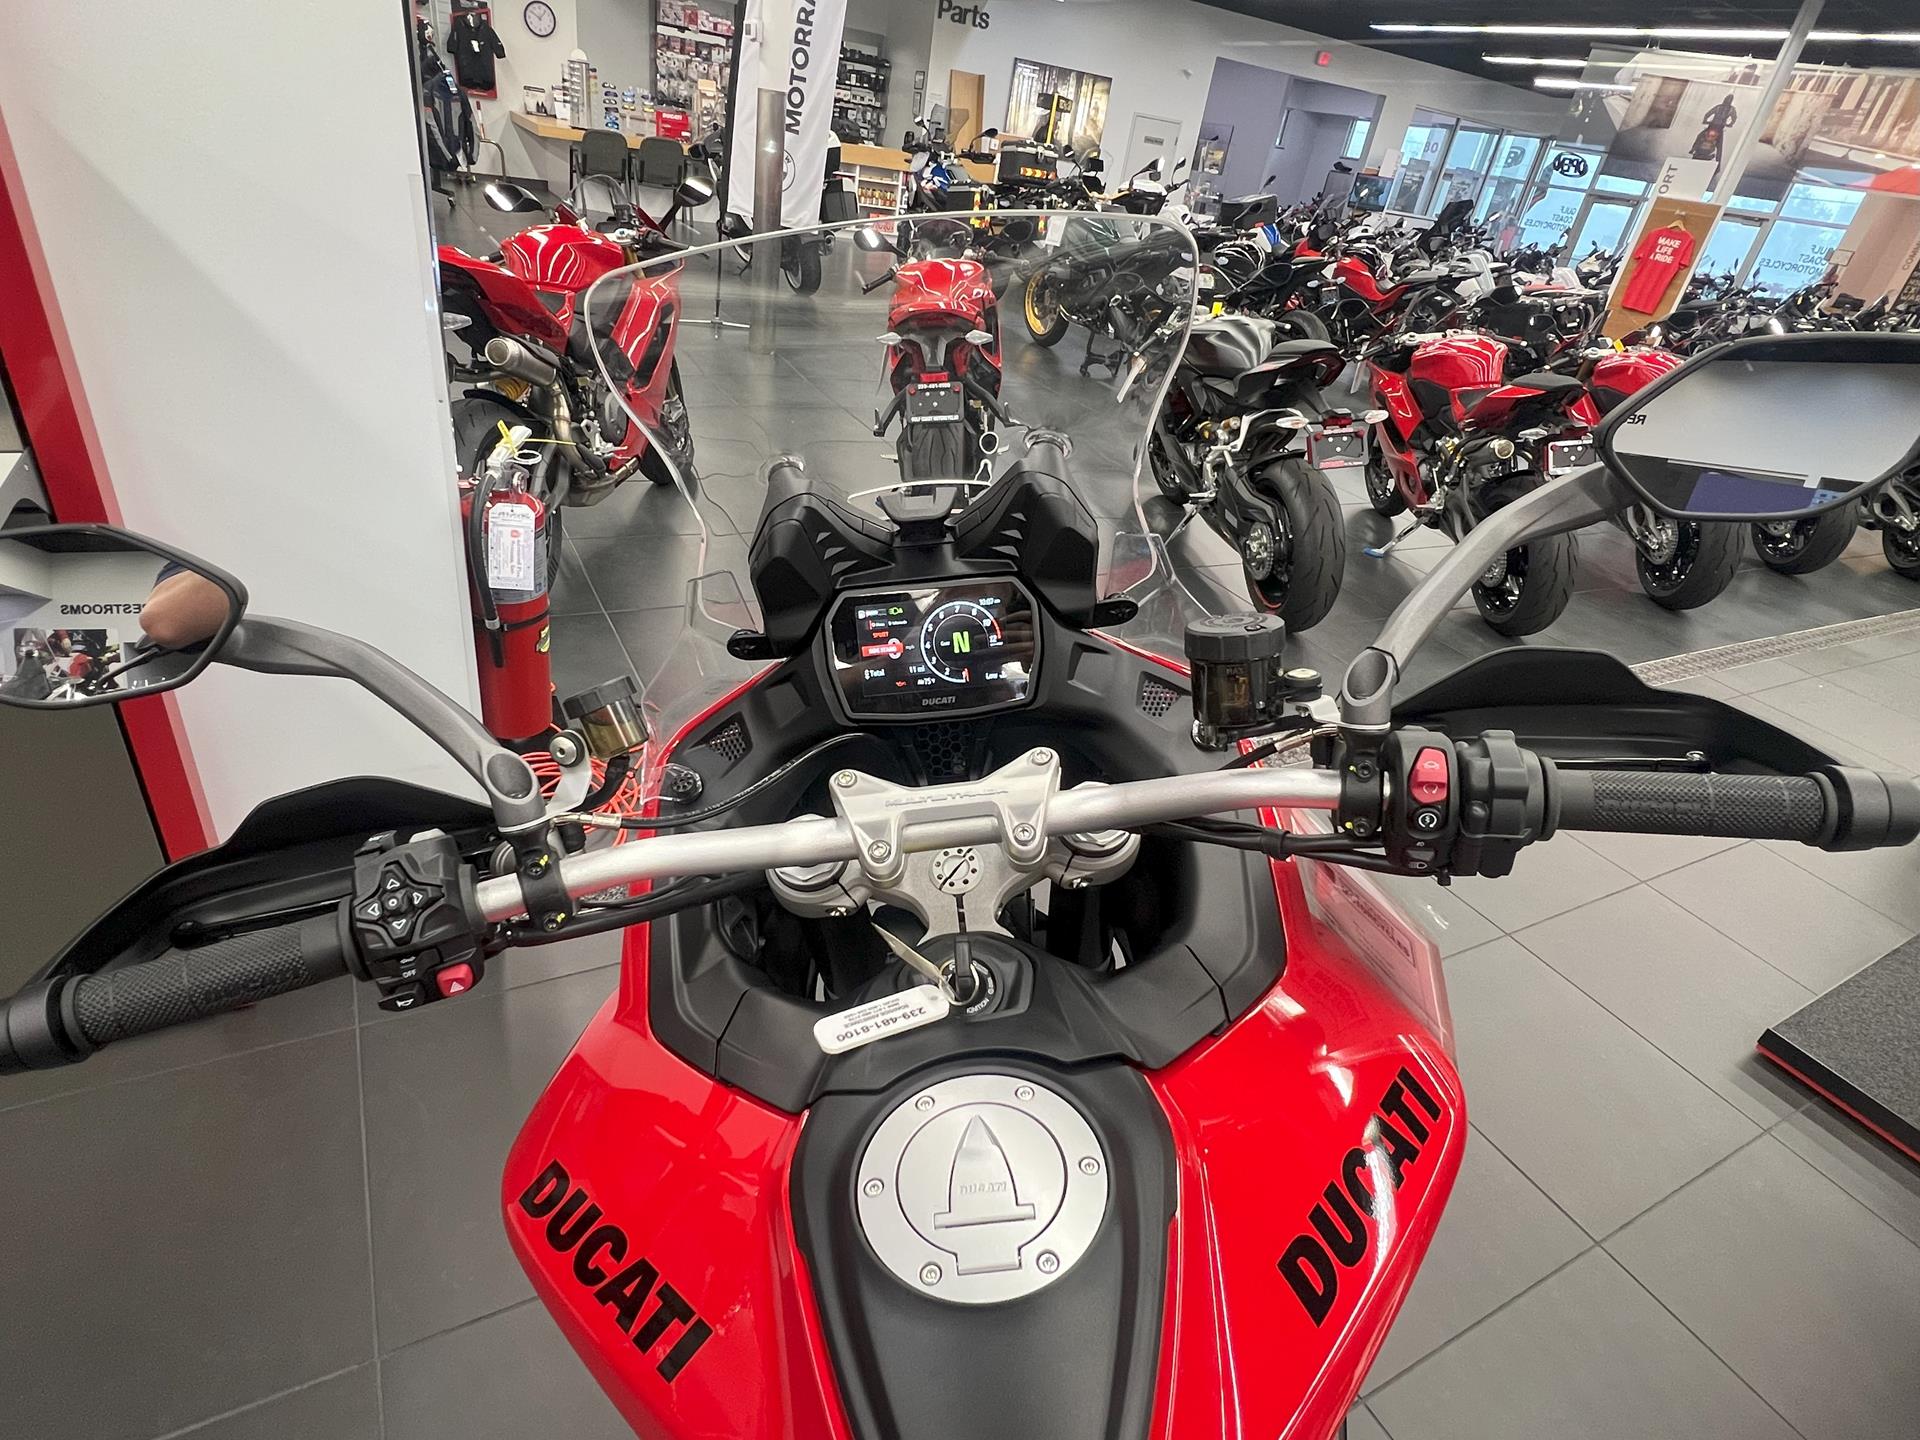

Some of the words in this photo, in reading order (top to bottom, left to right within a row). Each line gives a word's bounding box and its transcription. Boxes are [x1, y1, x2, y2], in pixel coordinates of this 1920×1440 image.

[938, 0, 990, 29] Parts
[1656, 246, 1674, 255] LIFE
[1657, 236, 1682, 248] MAKE
[1654, 252, 1674, 263] RIDE
[953, 631, 970, 653] N
[922, 696, 956, 706] DUCATI
[402, 969, 417, 979] OFF
[836, 1006, 926, 1042] 239-481-8100
[1277, 1065, 1442, 1328] DUCATI
[518, 1159, 714, 1384] DUCATI
